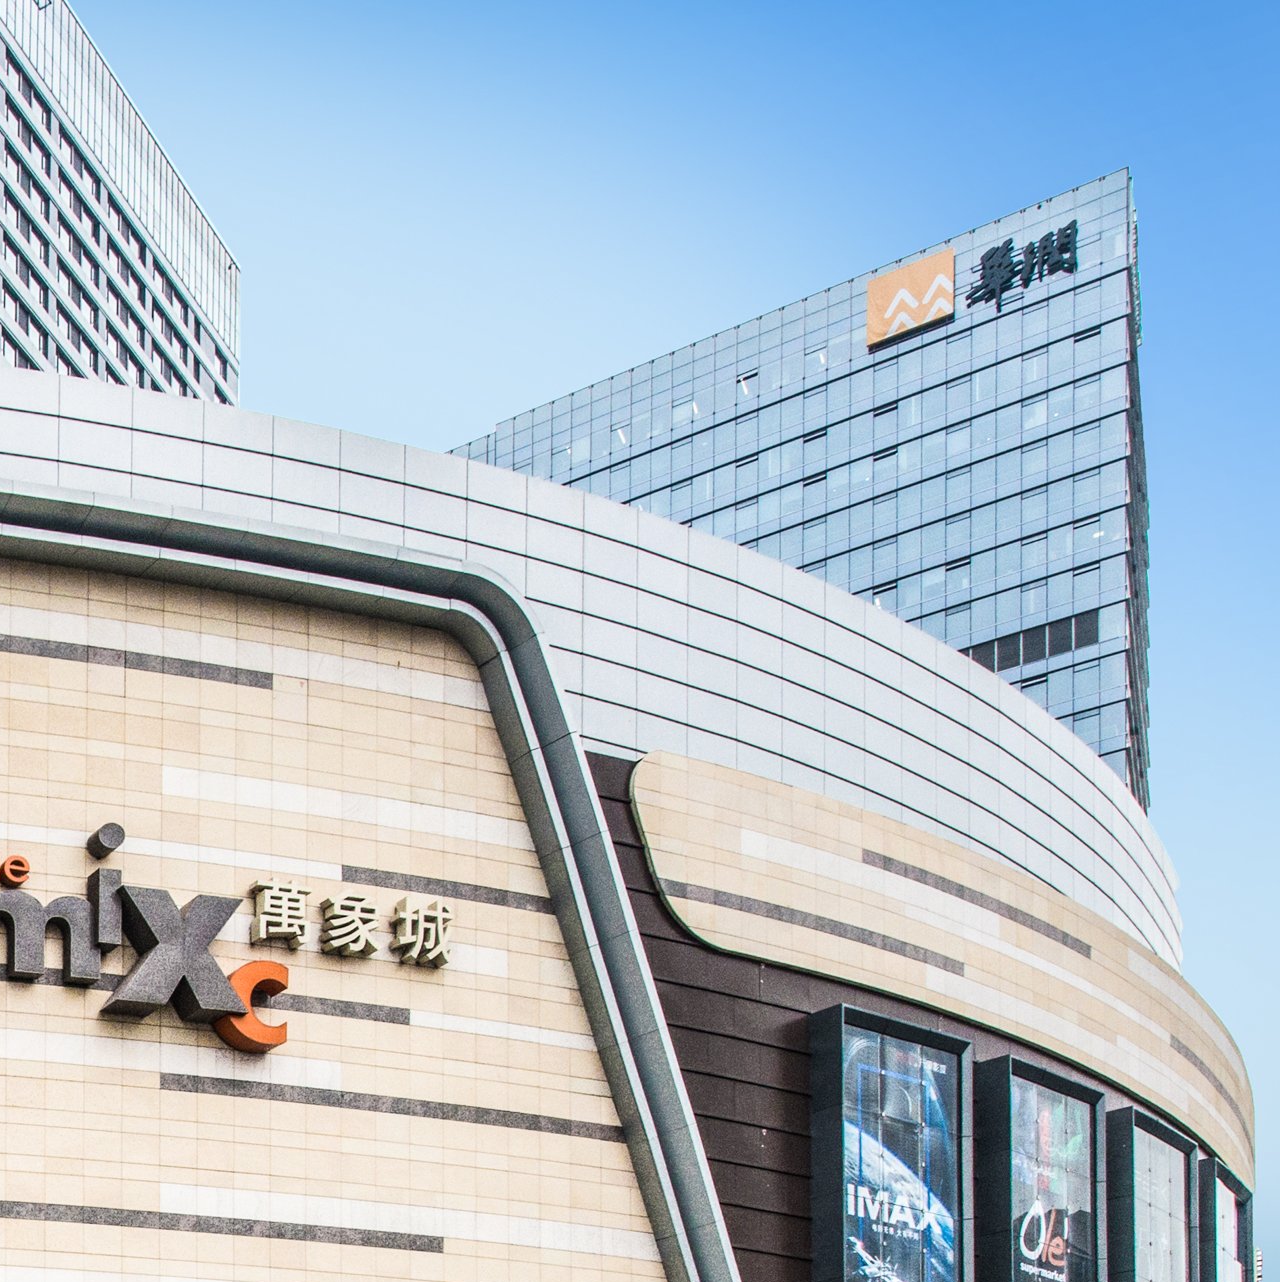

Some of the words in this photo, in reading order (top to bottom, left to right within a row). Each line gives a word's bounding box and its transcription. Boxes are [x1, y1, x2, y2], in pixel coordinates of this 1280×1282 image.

[250, 877, 454, 968] 萬象城
[847, 1183, 943, 1236] IMAX
